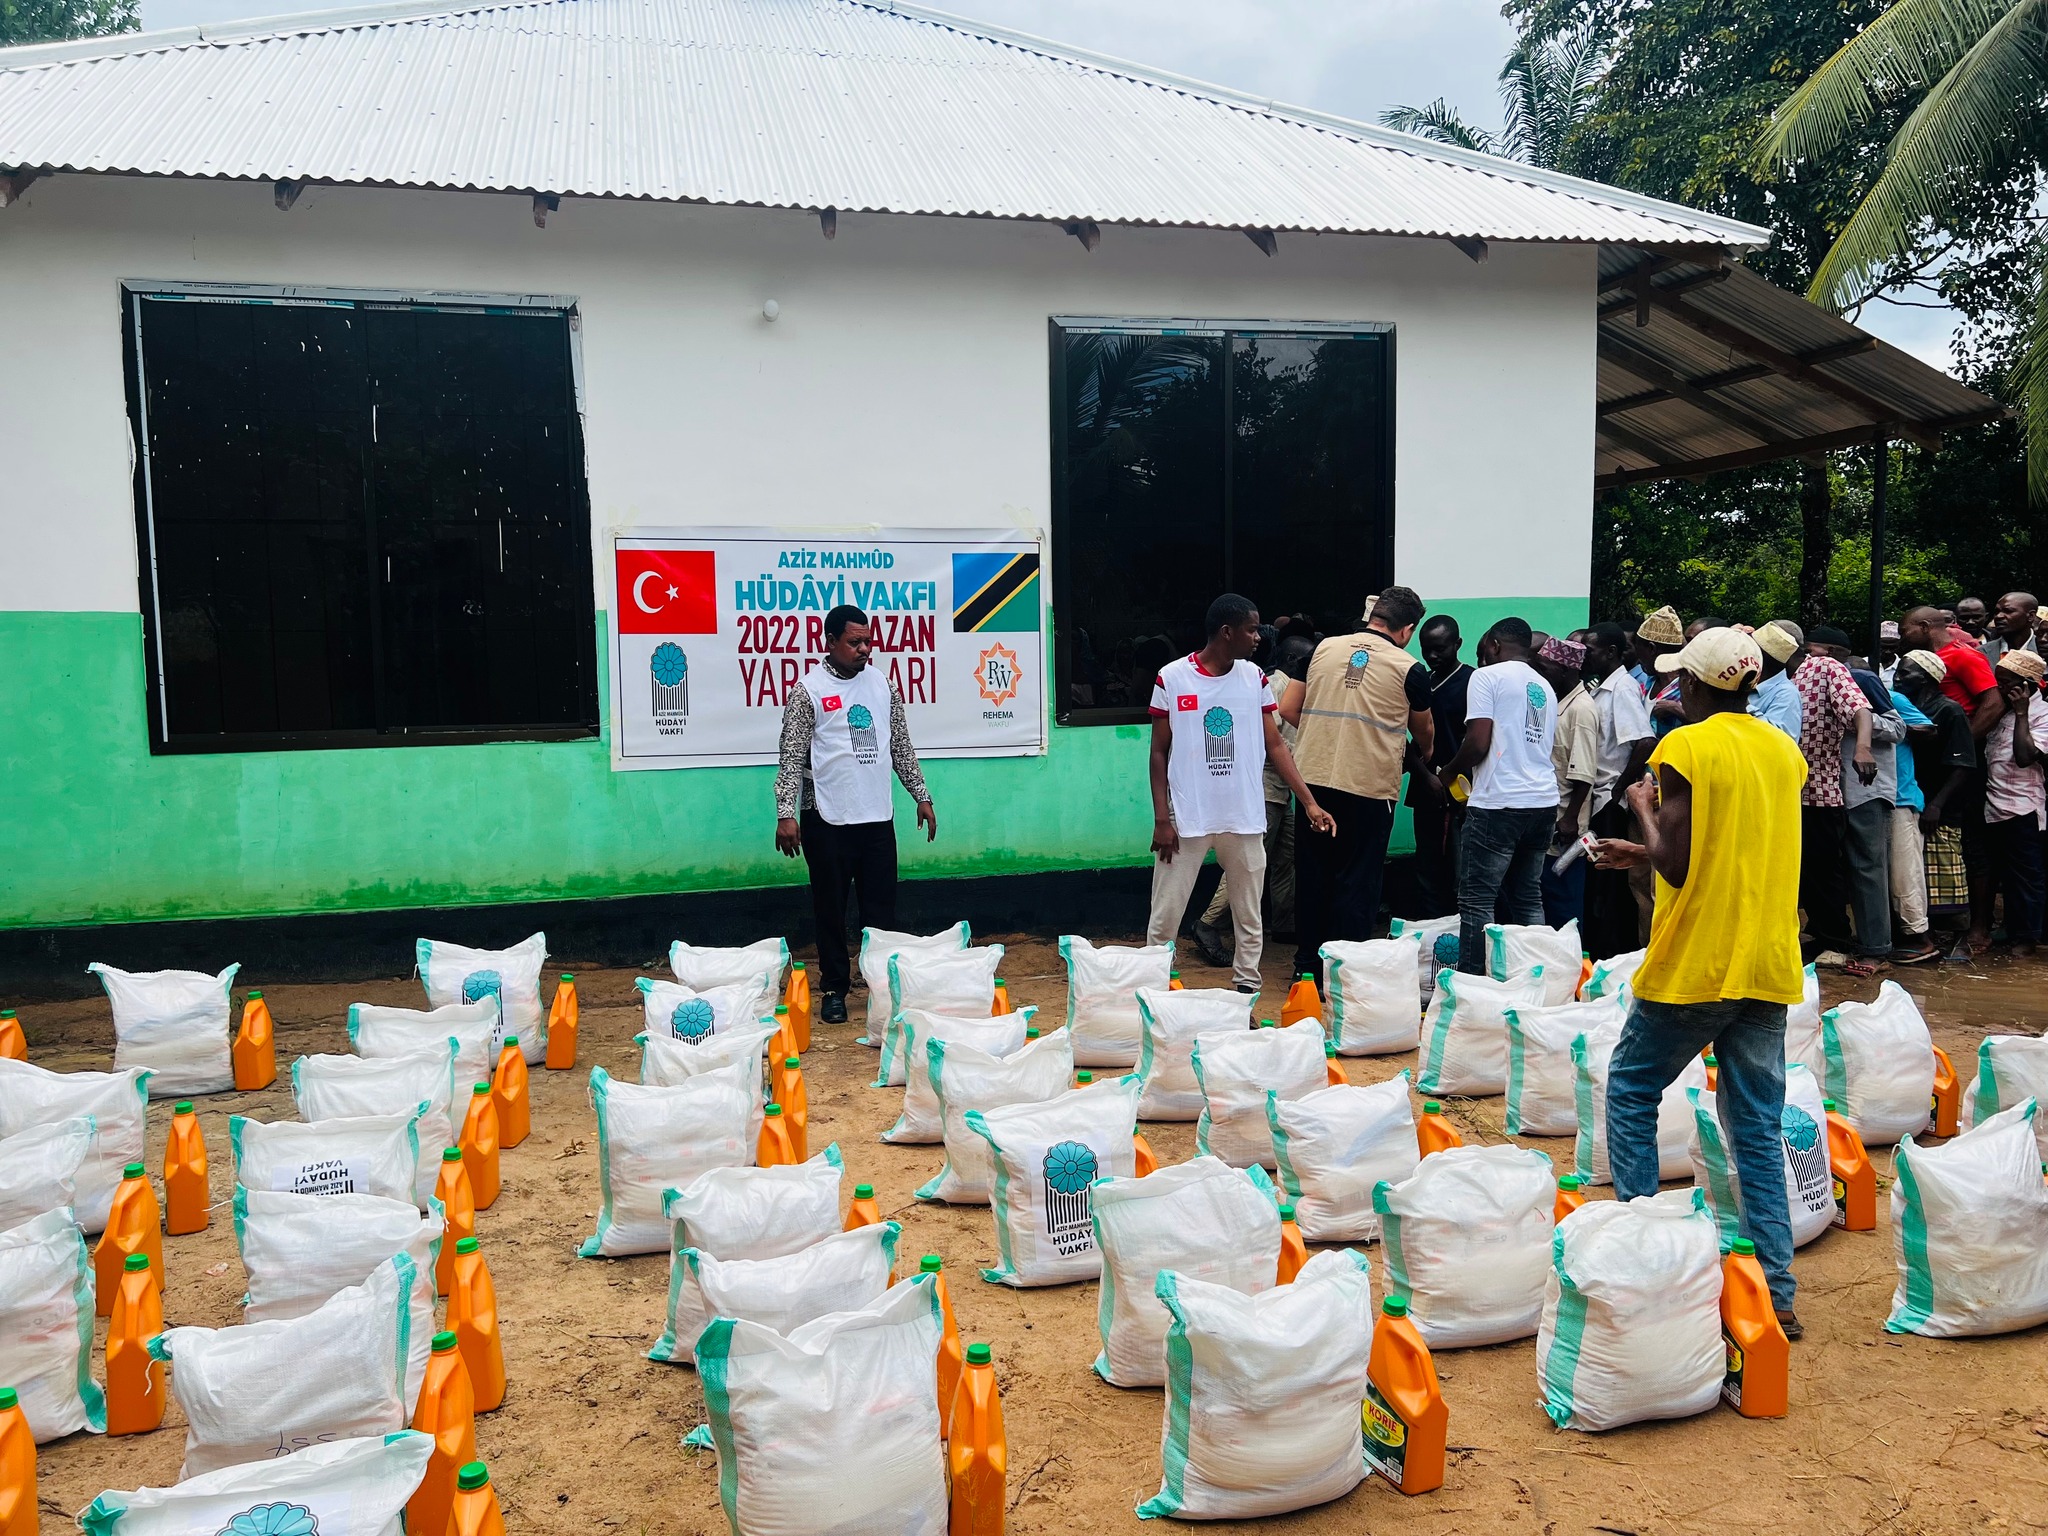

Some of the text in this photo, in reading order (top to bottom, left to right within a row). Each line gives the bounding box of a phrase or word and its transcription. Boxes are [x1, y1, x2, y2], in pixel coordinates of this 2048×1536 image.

[778, 548, 894, 569] AZİZ MAHMÛD
[735, 573, 936, 611] HÜDÂYİ VAKFI
[737, 615, 936, 654] 2022 RAZAN
[982, 711, 1014, 720] REHEMA
[658, 728, 684, 736] VAKFI
[302, 1159, 343, 1173] VAKFI
[1052, 1229, 1094, 1246] HÜDÂY
[1368, 1403, 1398, 1433] KORIE
